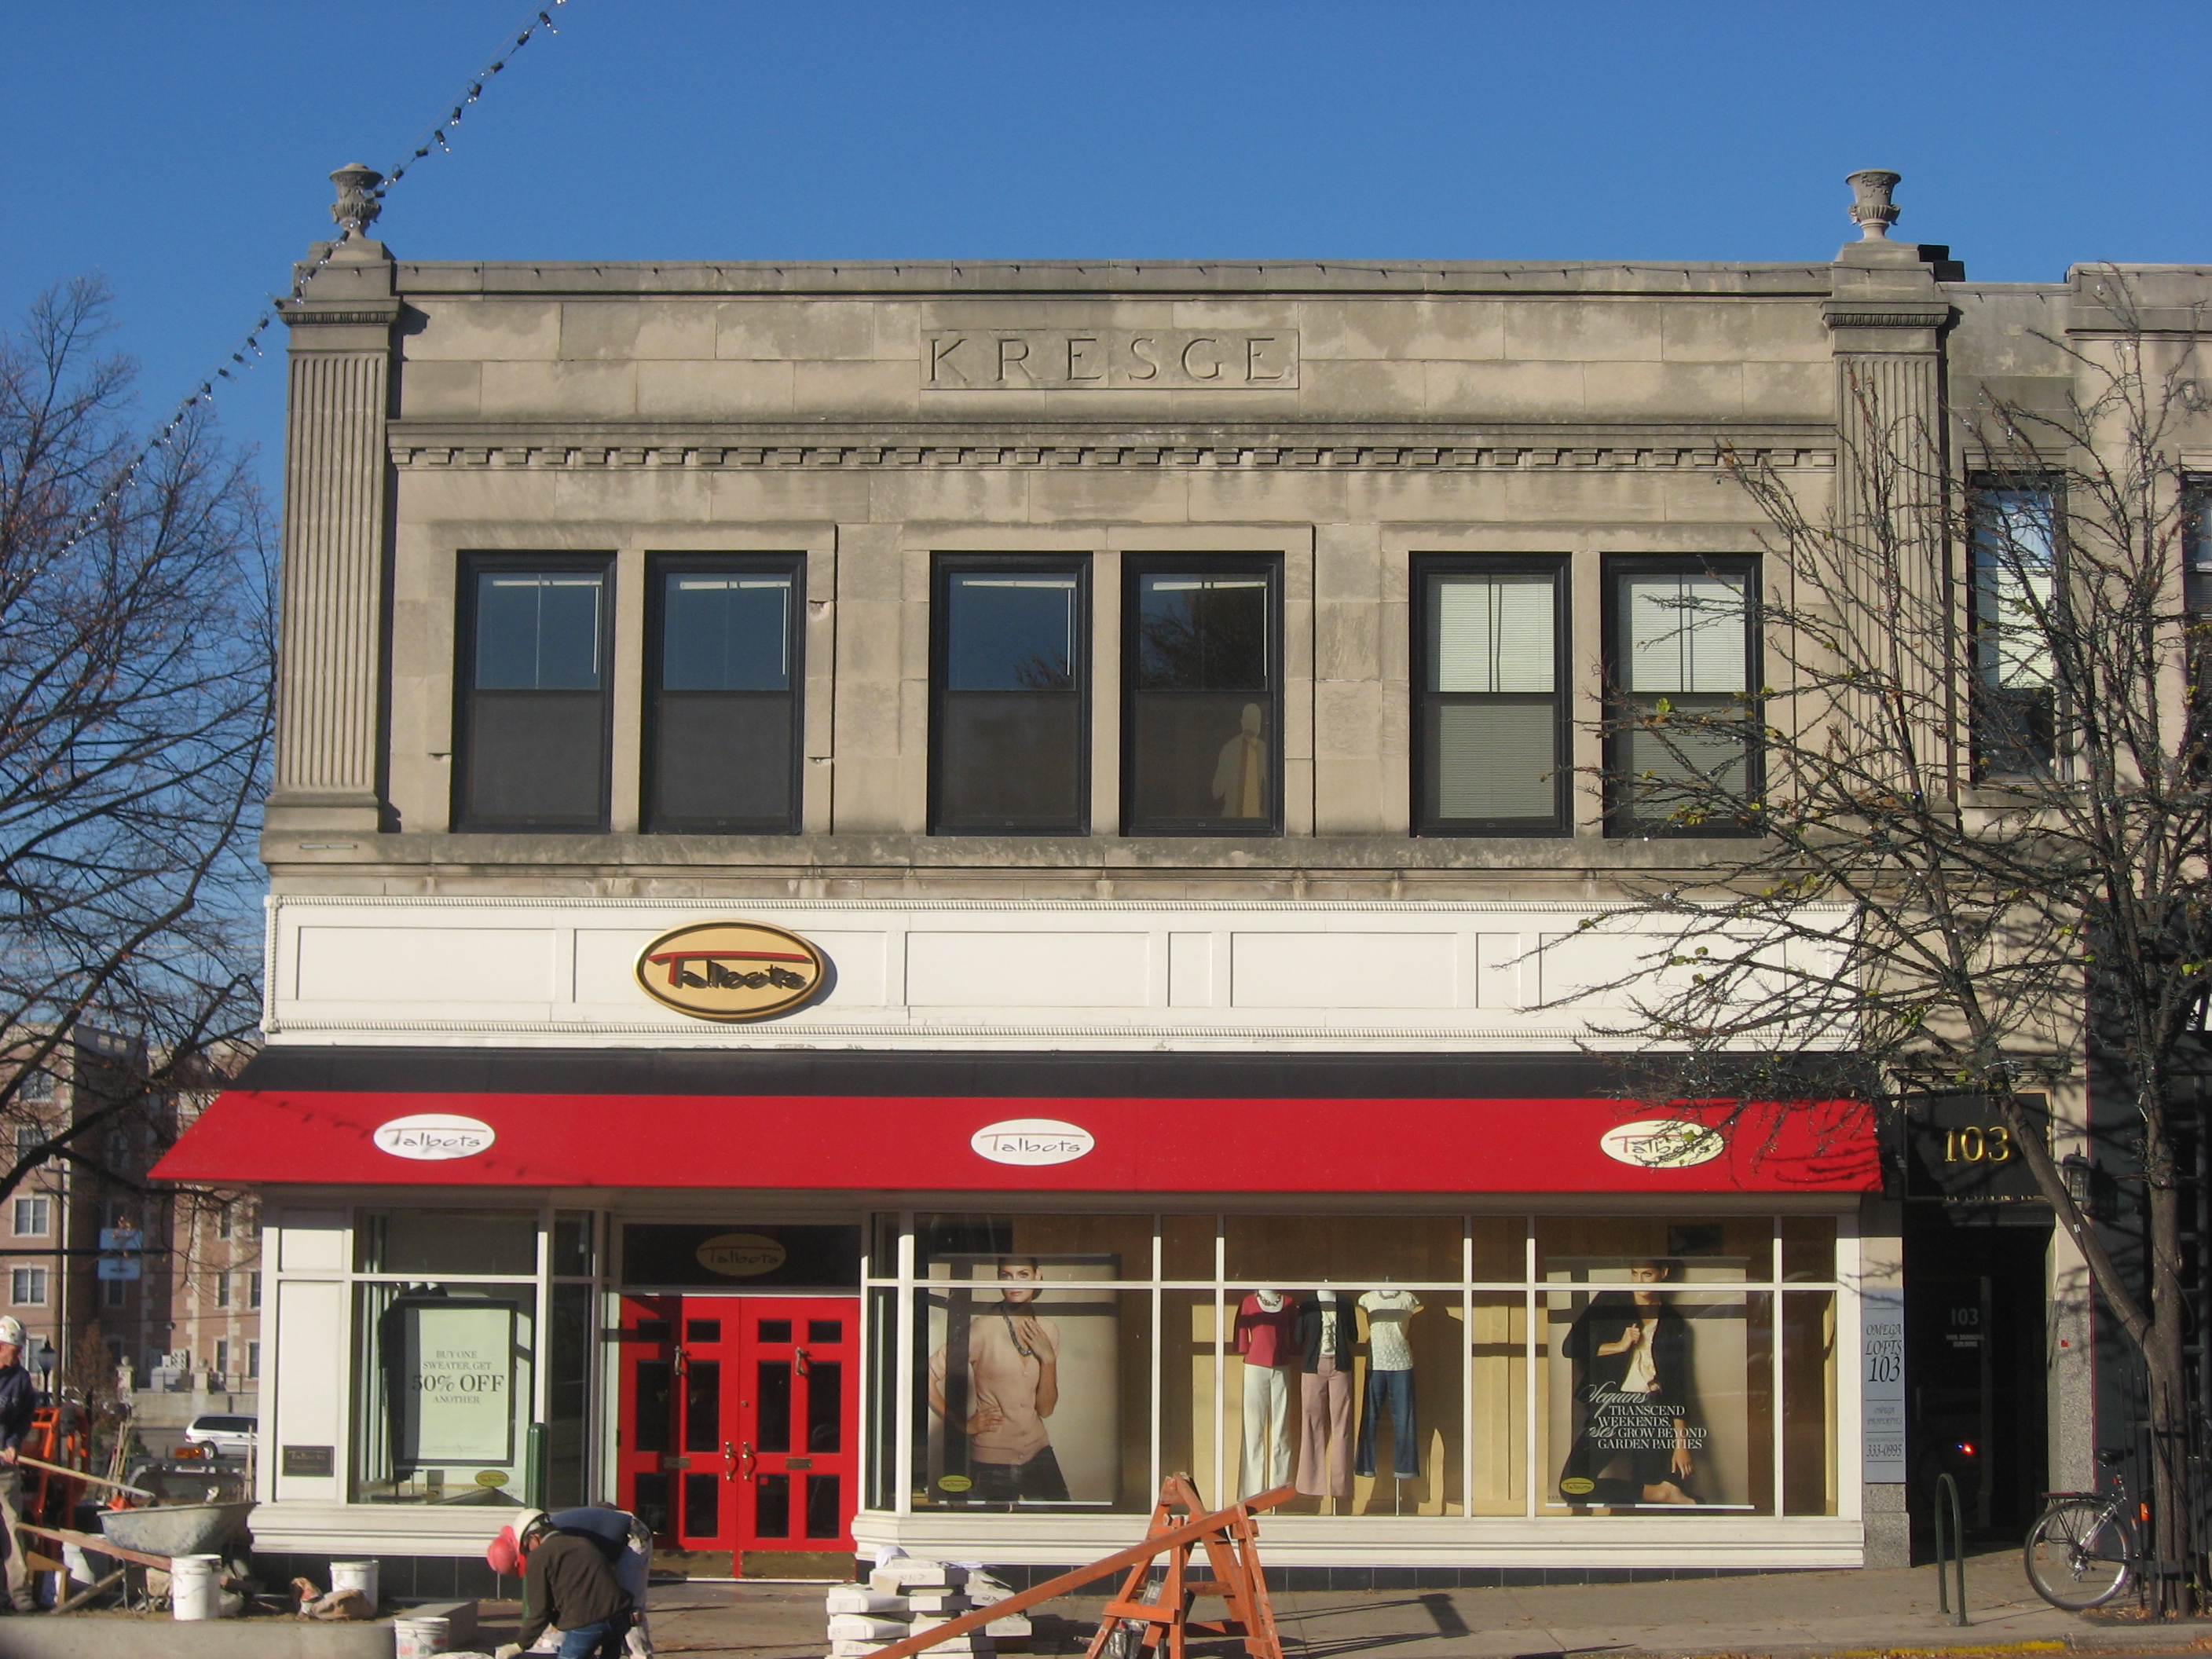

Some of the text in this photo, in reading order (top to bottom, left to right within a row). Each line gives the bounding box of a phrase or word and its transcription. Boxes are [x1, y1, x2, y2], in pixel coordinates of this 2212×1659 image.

[928, 337, 1287, 382] KRESGE
[646, 950, 811, 990] Talbots
[383, 1127, 487, 1148] Talbots
[980, 1133, 1086, 1152] Talbots
[1943, 1125, 2010, 1163] 103
[701, 1245, 782, 1264] Talbots
[1951, 1307, 1979, 1326] 103
[1866, 1324, 1902, 1339] OMEGA
[435, 1350, 478, 1359] BUY ONE
[1865, 1339, 1903, 1357] LOFTS
[472, 1361, 492, 1370] GET
[1868, 1356, 1900, 1382] 103
[412, 1374, 504, 1393] 50% OFF
[433, 1395, 480, 1404] ANOTHER
[1609, 1405, 1686, 1416] TRANSCEND
[1598, 1416, 1672, 1428] WEEKENDS,
[1617, 1427, 1655, 1438] GROW
[1657, 1427, 1707, 1438] BEYOND
[1597, 1438, 1703, 1449] GARDEN PARTIES
[1866, 1444, 1903, 1457] 333-0995
